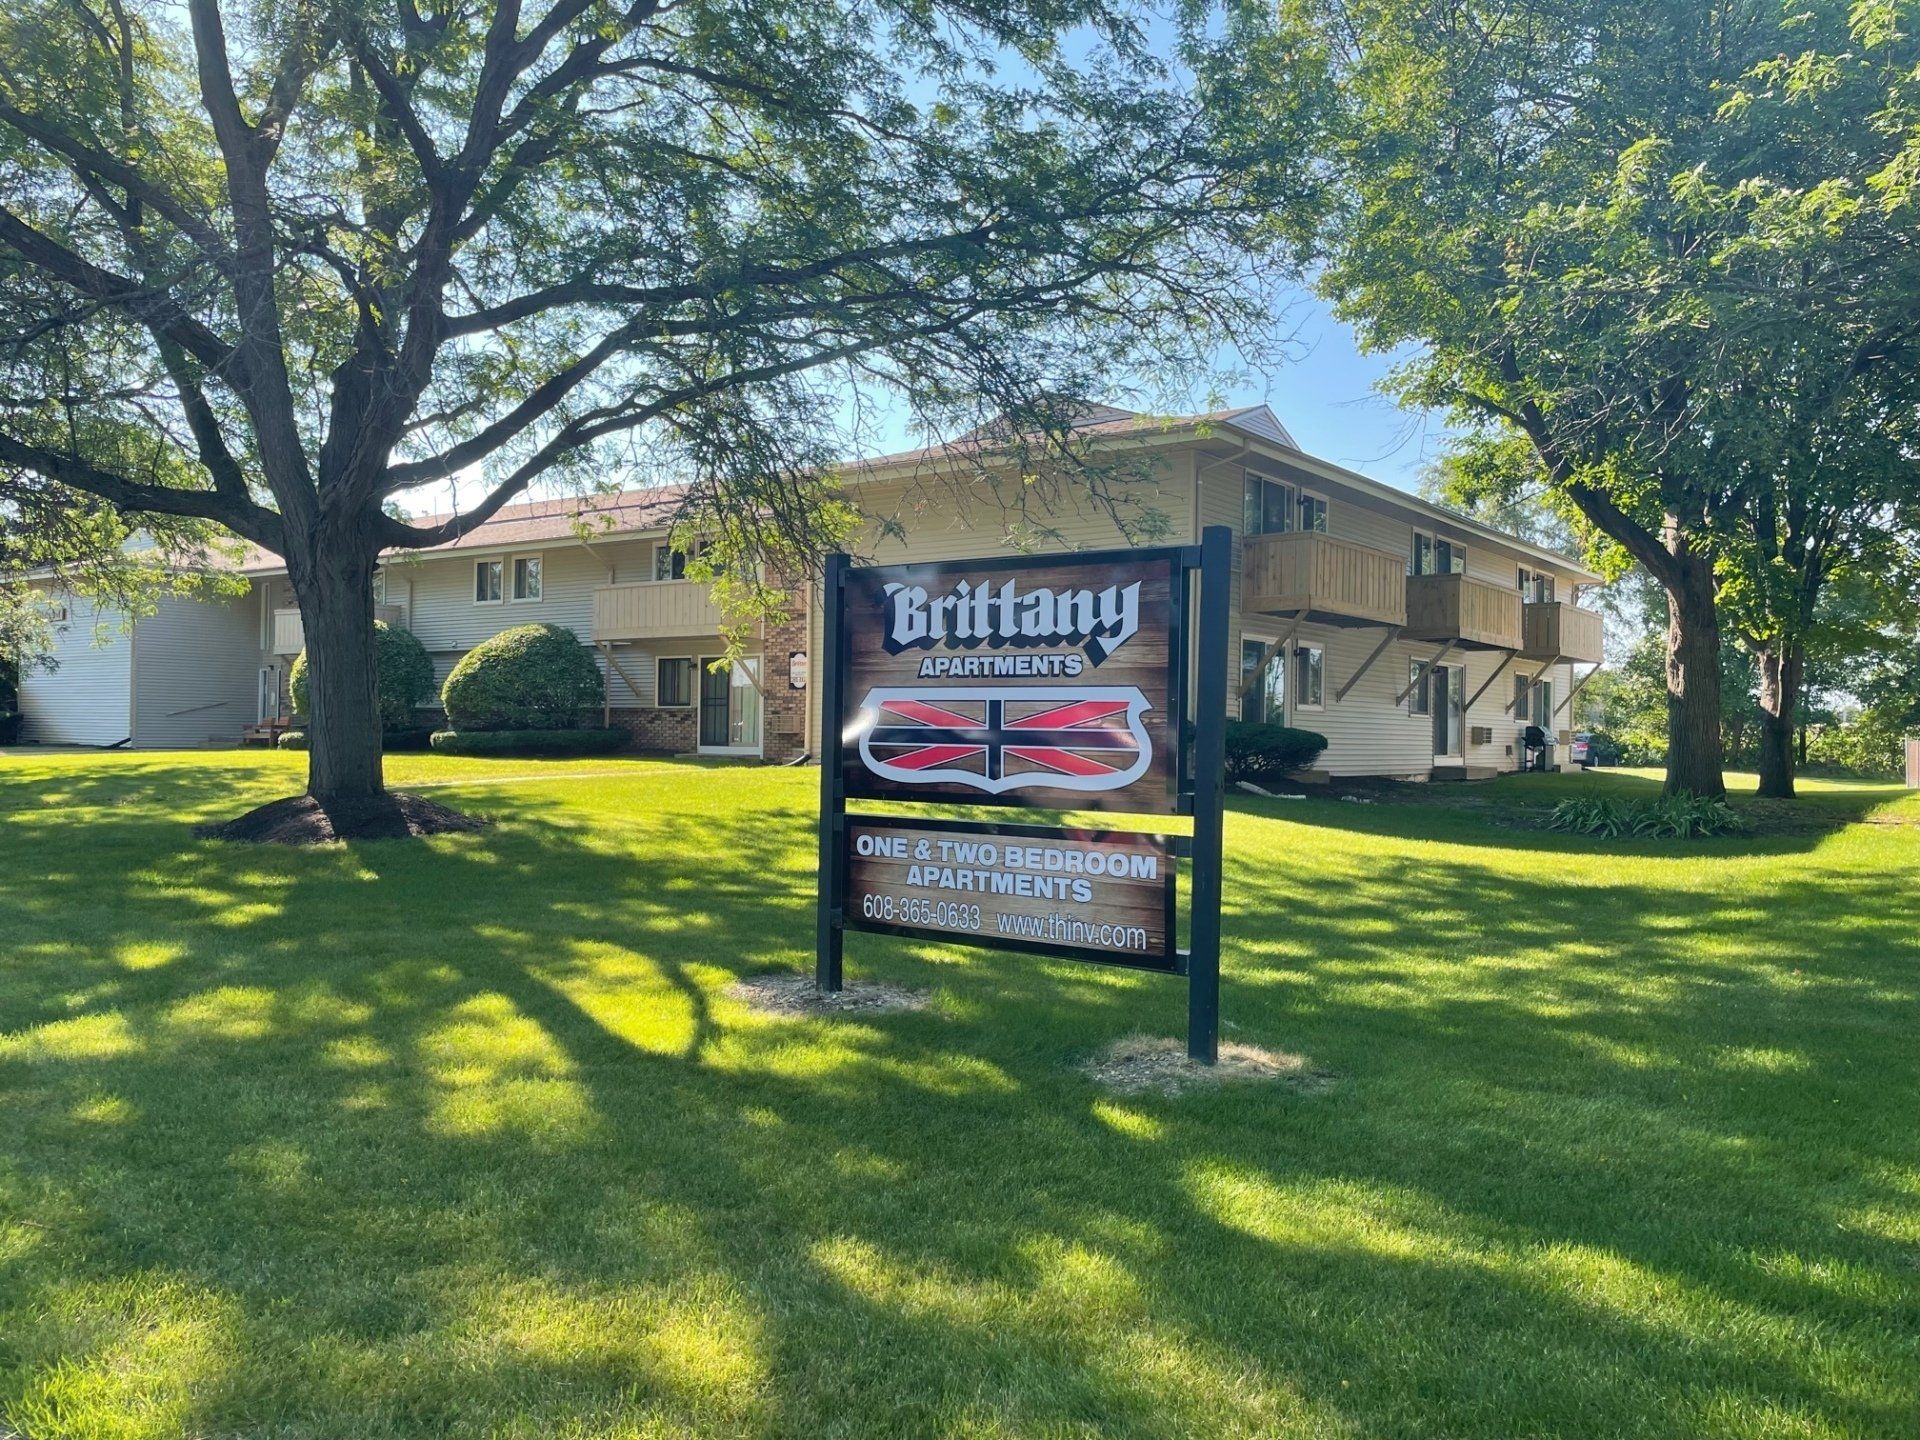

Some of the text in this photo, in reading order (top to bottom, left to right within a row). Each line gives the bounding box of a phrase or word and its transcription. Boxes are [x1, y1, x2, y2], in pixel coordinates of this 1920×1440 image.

[882, 578, 1142, 657] Brittany
[919, 655, 1082, 678] APARTMENTS
[856, 834, 1157, 879] ONE & TWO BEDROOM
[906, 866, 1092, 902] APARTMENTS
[863, 894, 1147, 950] 608-365-0633 www.thinv.com
